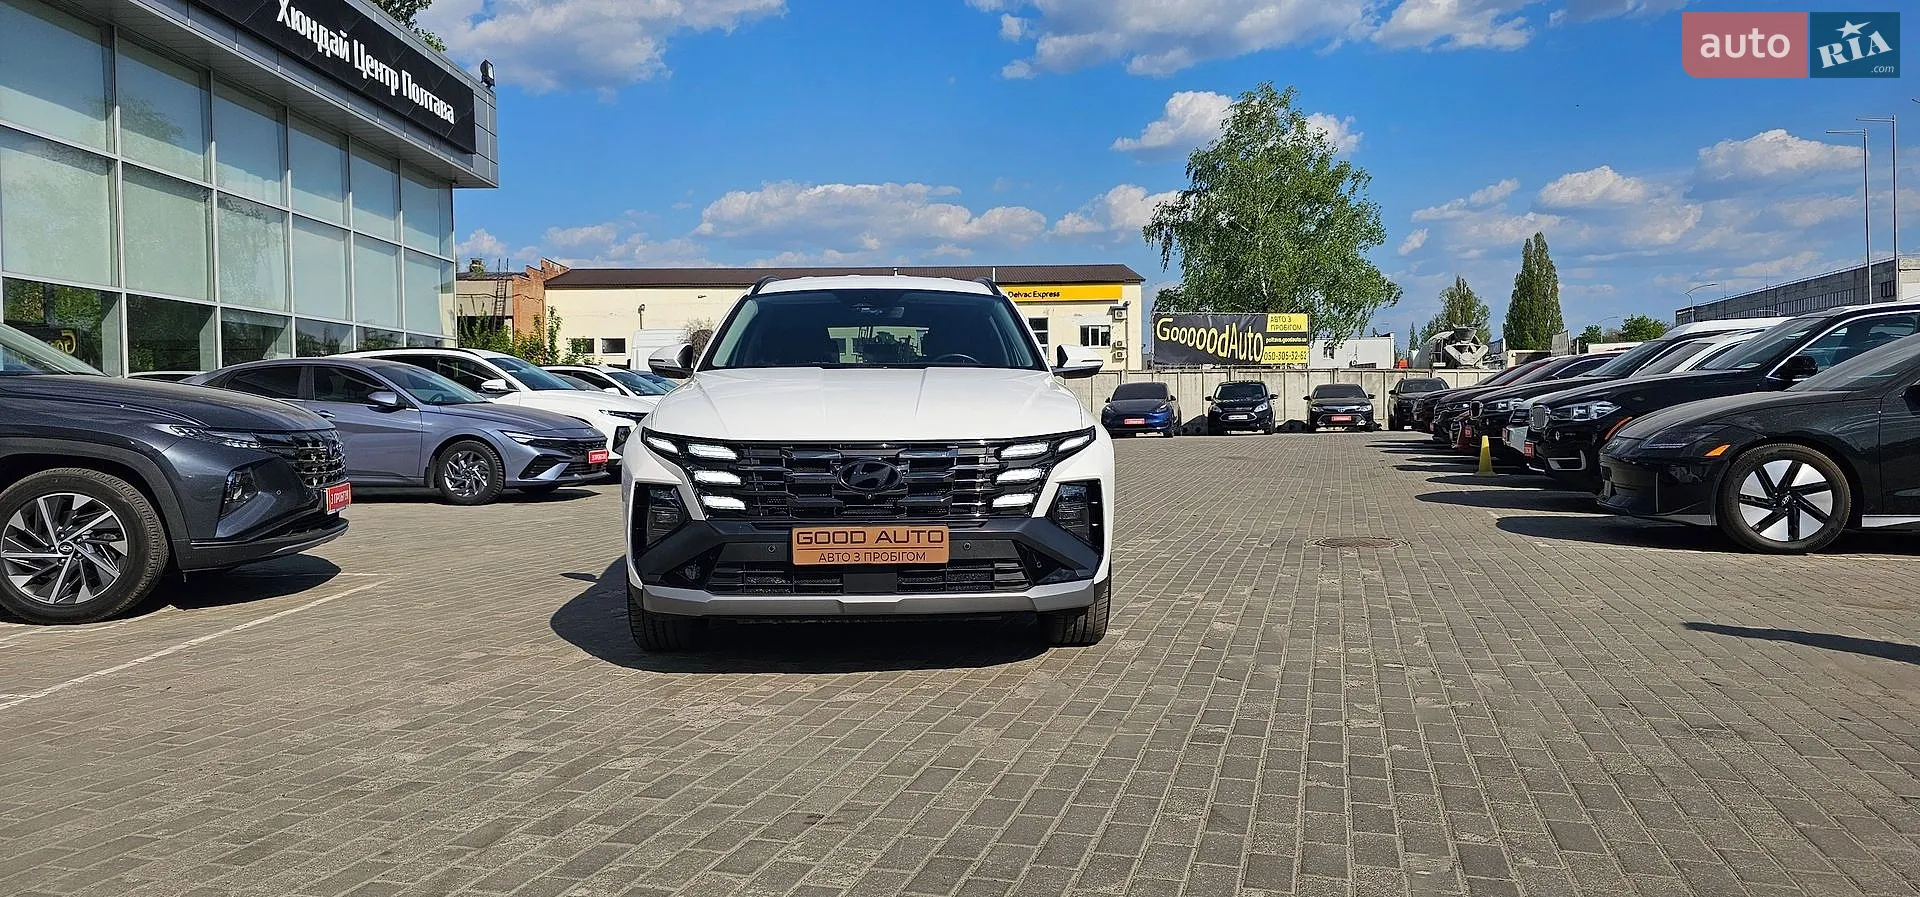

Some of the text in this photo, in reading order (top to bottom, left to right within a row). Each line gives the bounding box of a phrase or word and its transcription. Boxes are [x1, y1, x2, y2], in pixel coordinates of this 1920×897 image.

[276, 0, 455, 125] Хюндай Центр Полтава
[1007, 290, 1061, 300] Delvac Express
[1270, 315, 1287, 323] АВТО
[796, 529, 944, 545] GOOD AUTO
[818, 551, 926, 563] АВТО З ПРОБІГОМ
